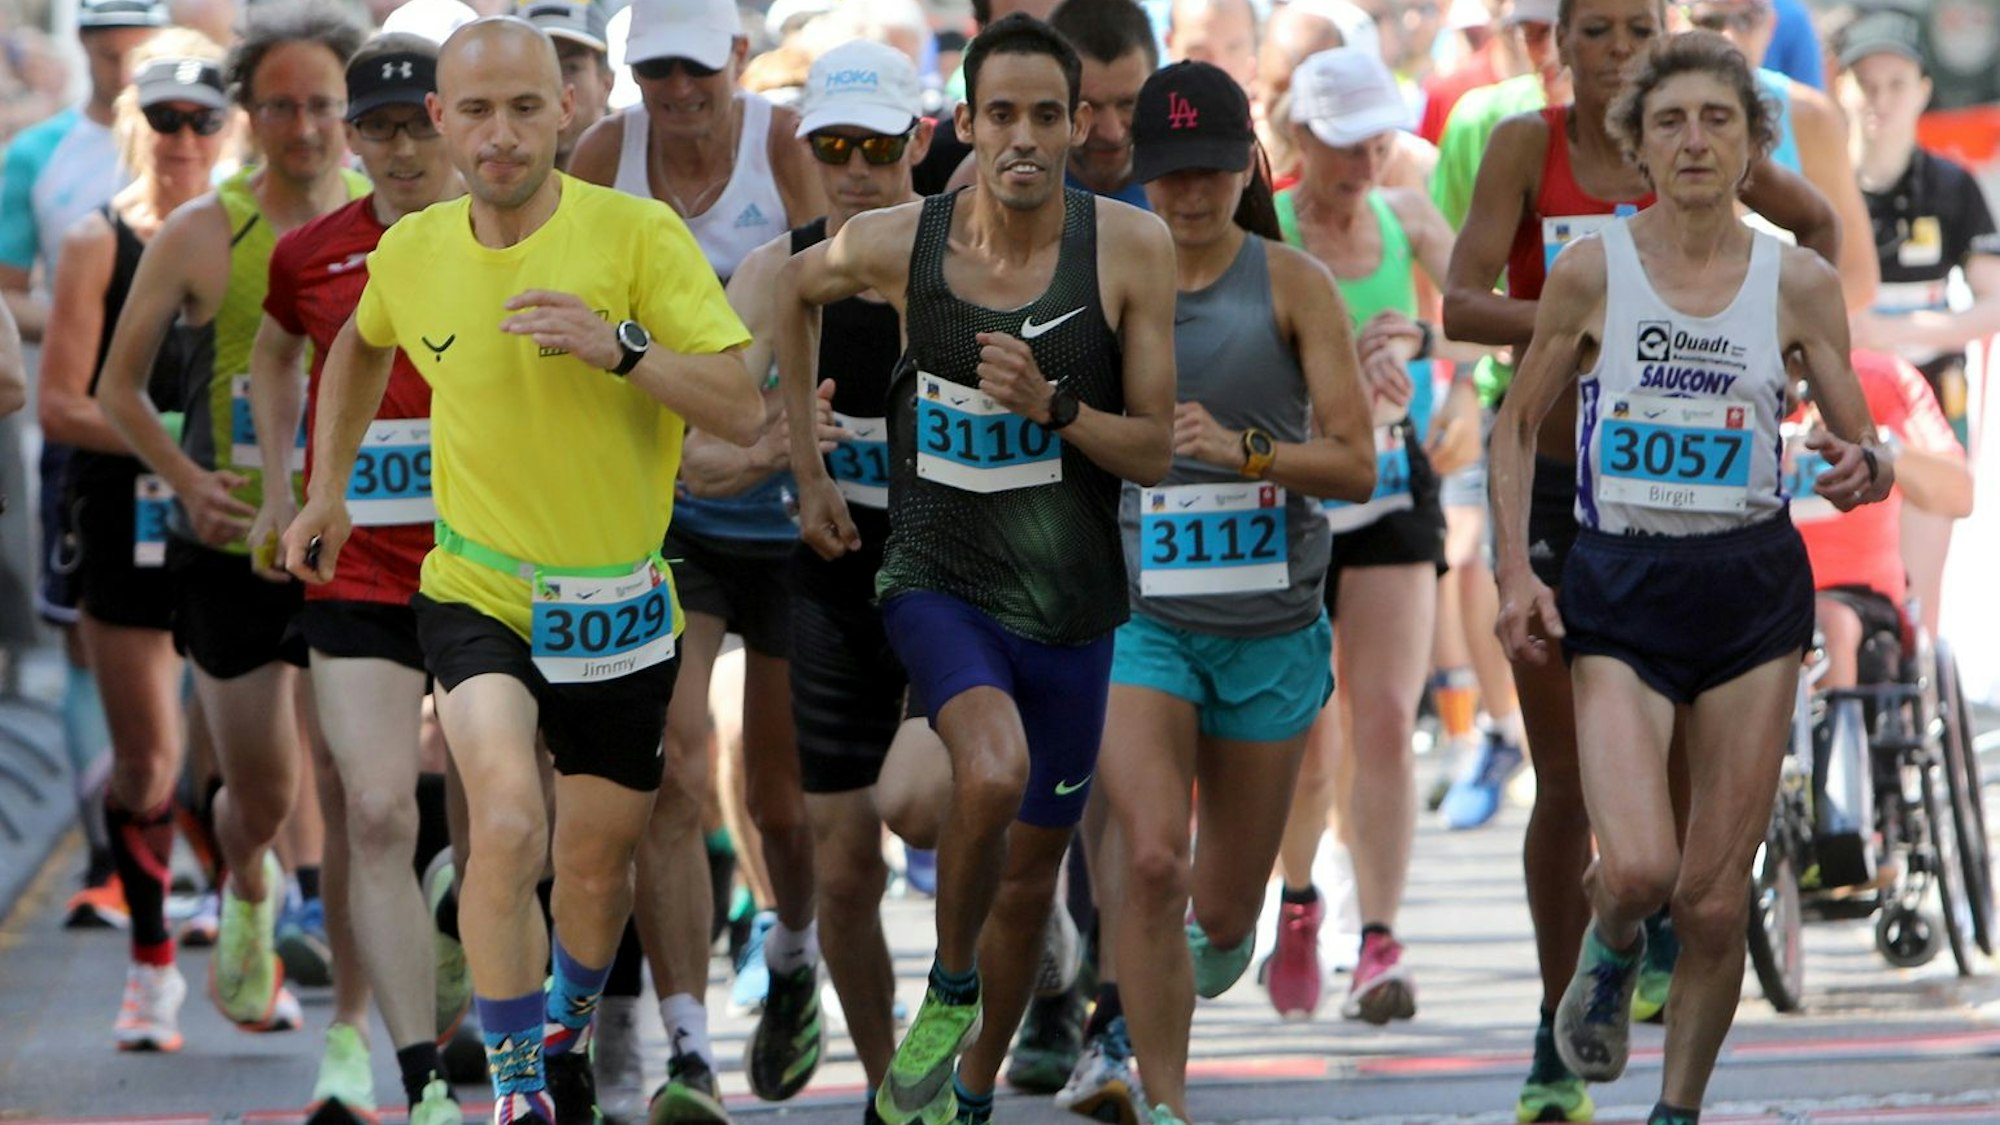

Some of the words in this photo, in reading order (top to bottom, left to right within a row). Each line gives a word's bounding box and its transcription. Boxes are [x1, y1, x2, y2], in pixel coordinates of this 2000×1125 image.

[826, 69, 878, 88] HOKA
[1168, 91, 1198, 128] LA
[1640, 364, 1737, 395] SAUCONY
[927, 408, 1052, 462] 3110
[1611, 427, 1742, 479] 3057
[1650, 485, 1695, 507] Birgit
[1152, 515, 1277, 563] 3112
[544, 593, 665, 652] 3029
[582, 657, 637, 677] Jimmy
